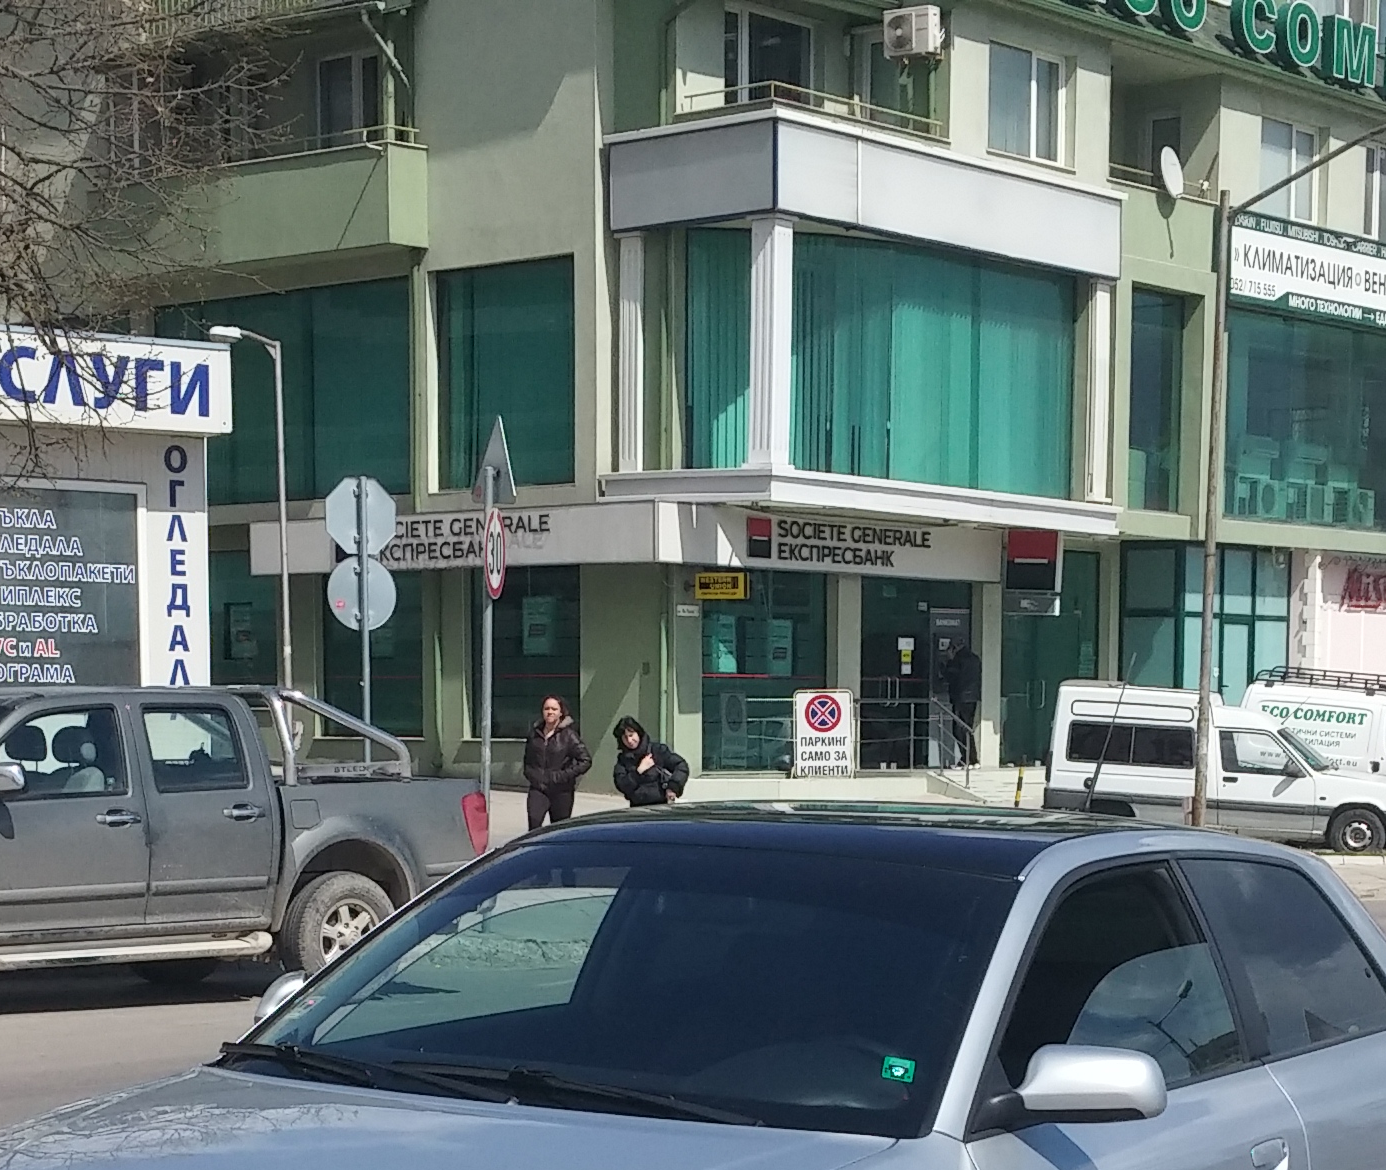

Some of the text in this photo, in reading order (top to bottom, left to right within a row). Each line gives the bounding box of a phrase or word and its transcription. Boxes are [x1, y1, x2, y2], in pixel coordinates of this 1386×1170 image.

[1260, 218, 1283, 235] FUJITSU
[1287, 224, 1319, 243] MITSUBISHI
[1323, 233, 1347, 249] TOSH
[1243, 244, 1353, 289] КЛИМАТИЗАЦИЯ
[1248, 280, 1262, 295] 715
[1263, 284, 1276, 297] 555
[1289, 294, 1316, 311] МНОГО
[1316, 299, 1362, 320] ТЕХНОЛОГИИ
[392, 513, 551, 539] CIETE GENRALE
[776, 519, 932, 549] SOCIETE GENERALE
[370, 537, 484, 562] КСПРЕСБАН
[488, 531, 502, 576] 30
[776, 543, 895, 568] ЕКСПРЕСБАНК
[19, 642, 31, 656] и
[33, 638, 60, 658] AL
[1293, 707, 1368, 726] COMFORT
[800, 736, 848, 747] ПАРКИНГ
[1291, 727, 1357, 739] ТИЧНИ СИСТЕМИ
[1304, 737, 1341, 748] ТИЛАЦИЯ
[800, 751, 848, 762] САМО ЗА
[800, 765, 849, 776] КЛИЕНТИ
